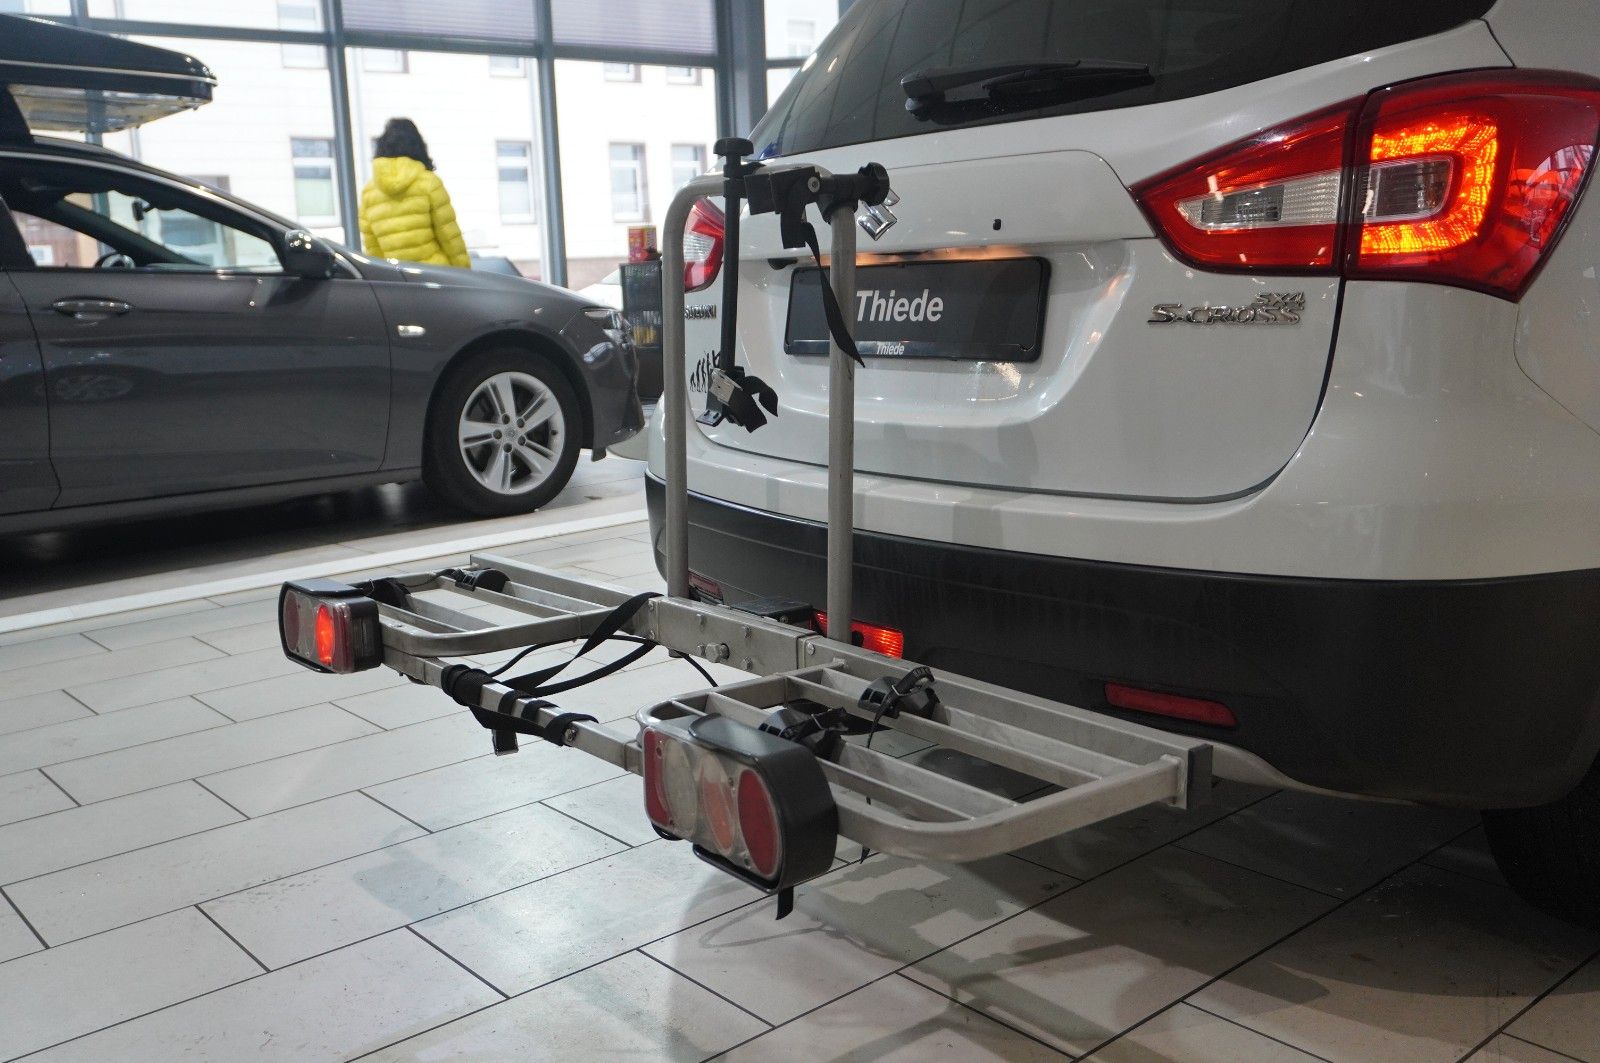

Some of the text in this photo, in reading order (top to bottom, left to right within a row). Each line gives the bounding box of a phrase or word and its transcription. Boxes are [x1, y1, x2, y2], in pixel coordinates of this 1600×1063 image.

[855, 288, 944, 323] Thiede
[1255, 291, 1306, 306] SX4
[875, 341, 906, 356] Thiede
